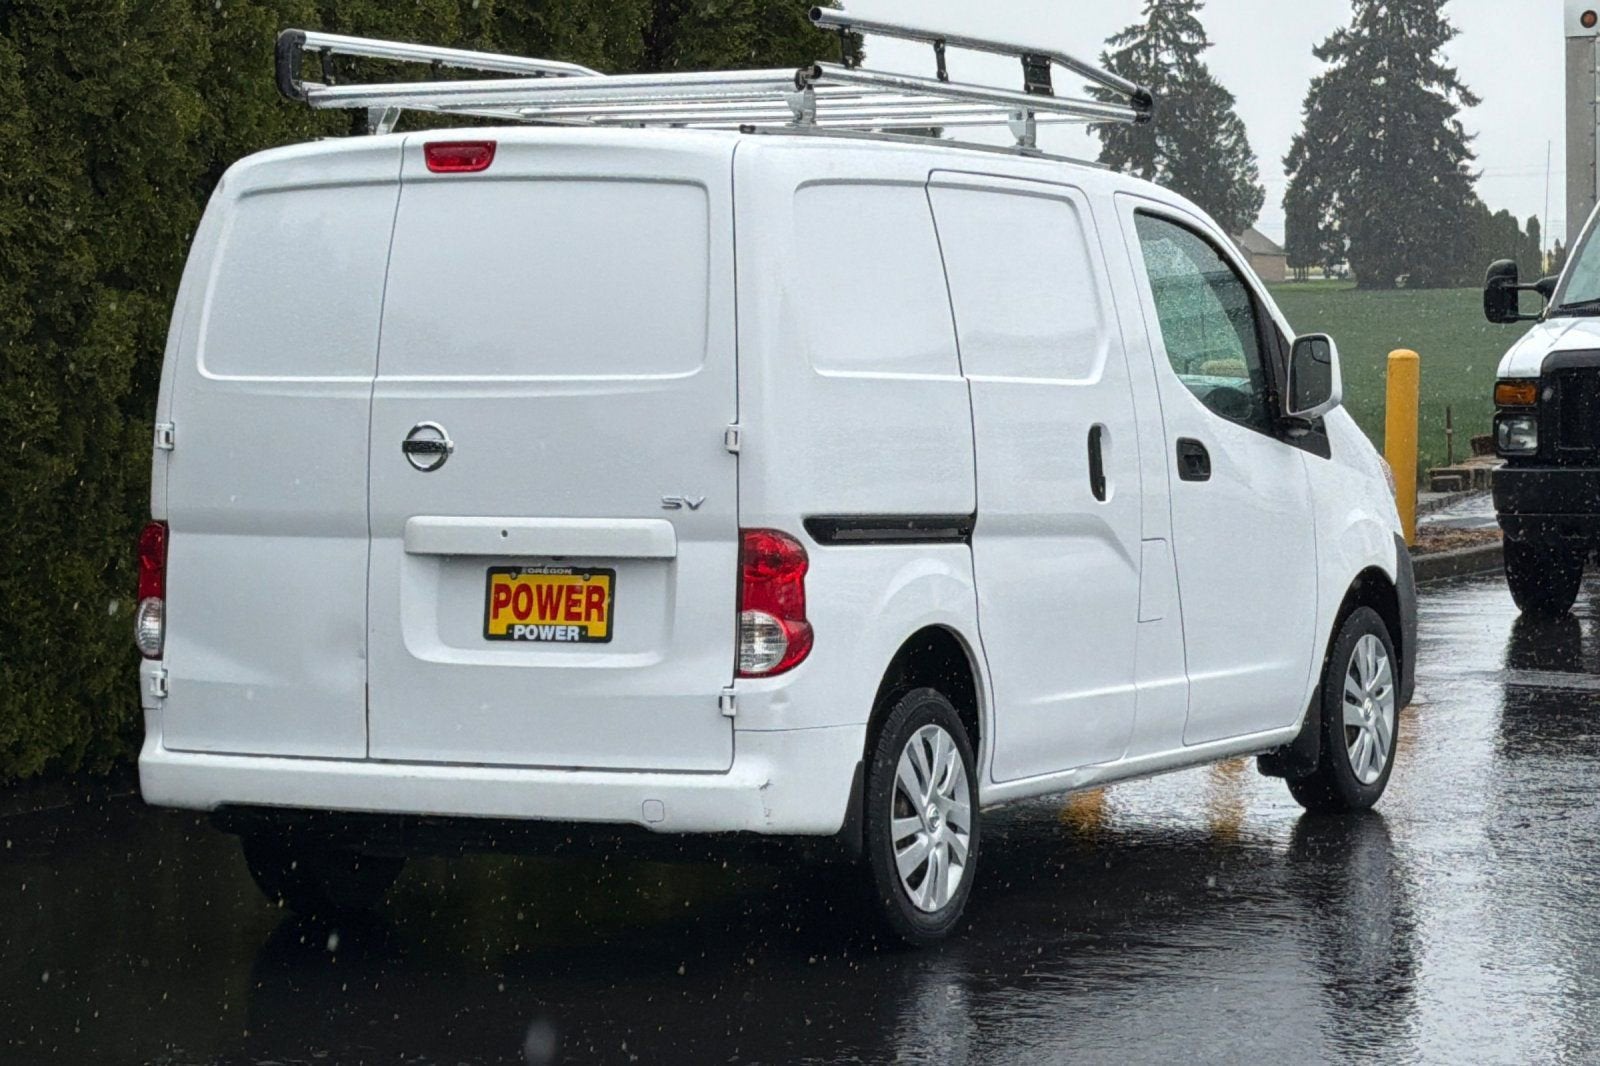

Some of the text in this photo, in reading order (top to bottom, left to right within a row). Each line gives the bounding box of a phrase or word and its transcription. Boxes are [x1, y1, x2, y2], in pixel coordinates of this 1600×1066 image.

[661, 496, 706, 511] SV
[492, 583, 606, 622] POWER
[513, 624, 580, 641] POWER
